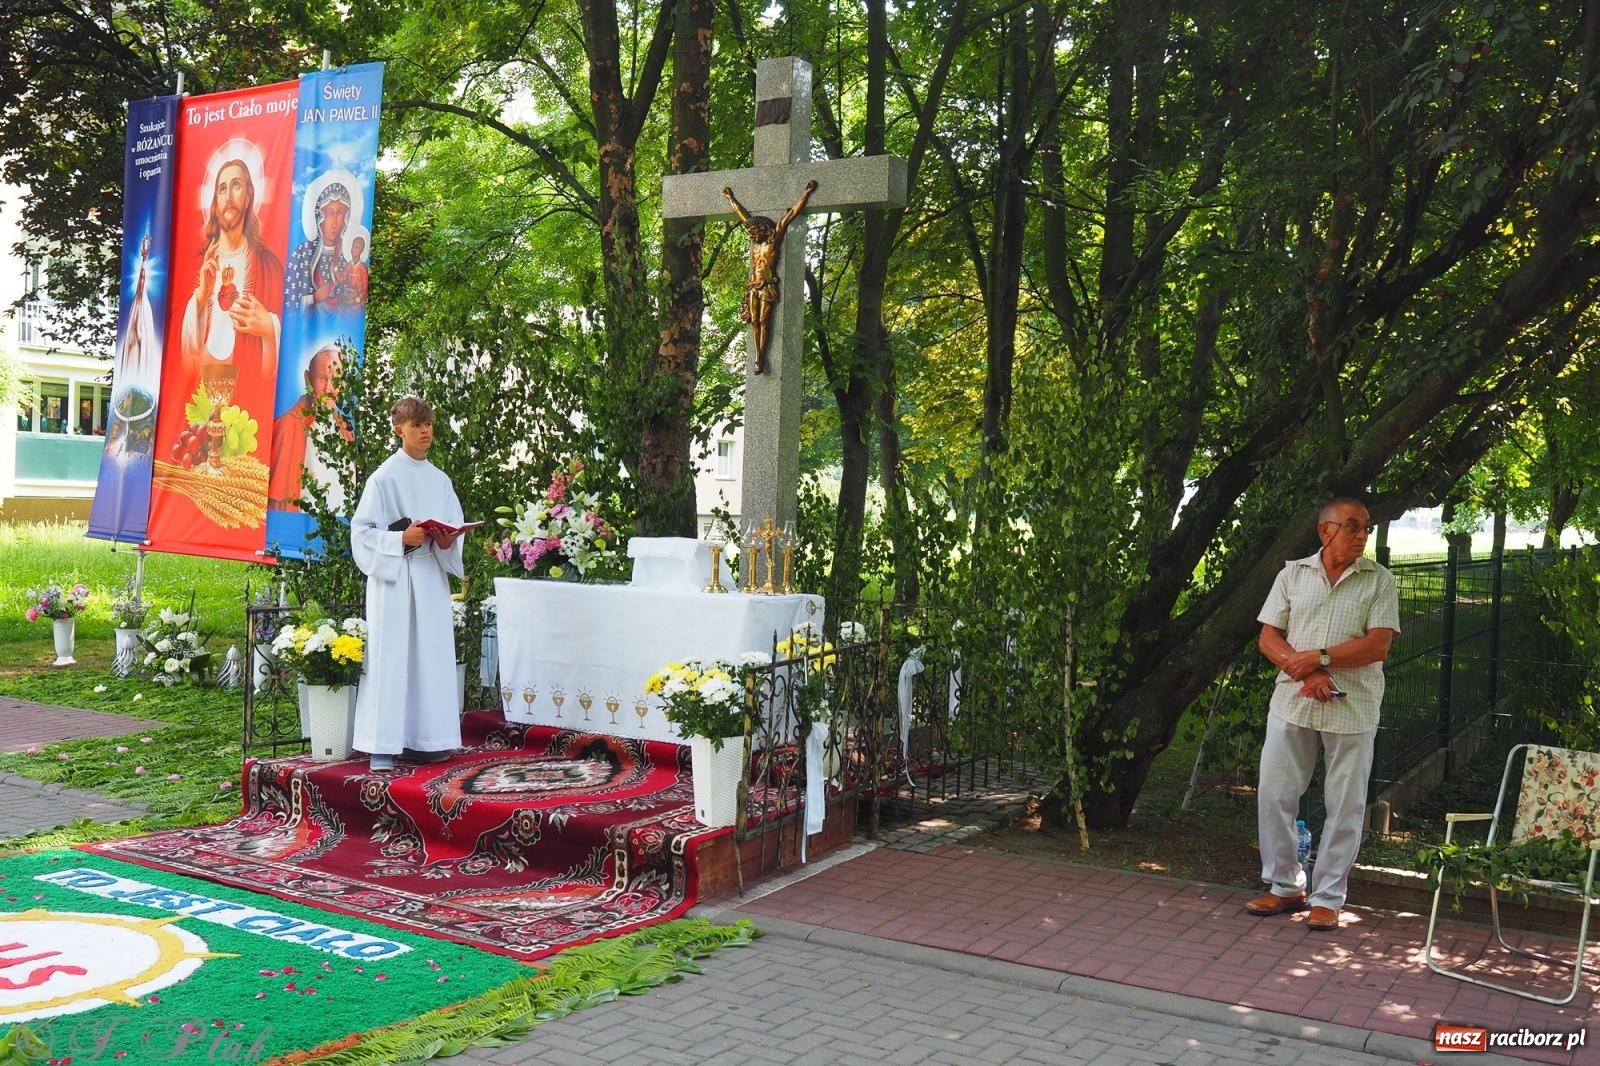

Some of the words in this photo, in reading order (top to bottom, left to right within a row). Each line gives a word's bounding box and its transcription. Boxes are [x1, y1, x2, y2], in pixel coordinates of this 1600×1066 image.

[323, 82, 361, 101] Święty
[186, 107, 201, 126] To
[203, 106, 225, 129] jest
[228, 98, 262, 120] Ciało
[265, 93, 299, 117] moje
[301, 108, 325, 124] JAN
[329, 104, 368, 122] PAWEŁ
[371, 104, 378, 119] II
[108, 888, 245, 916] JEST
